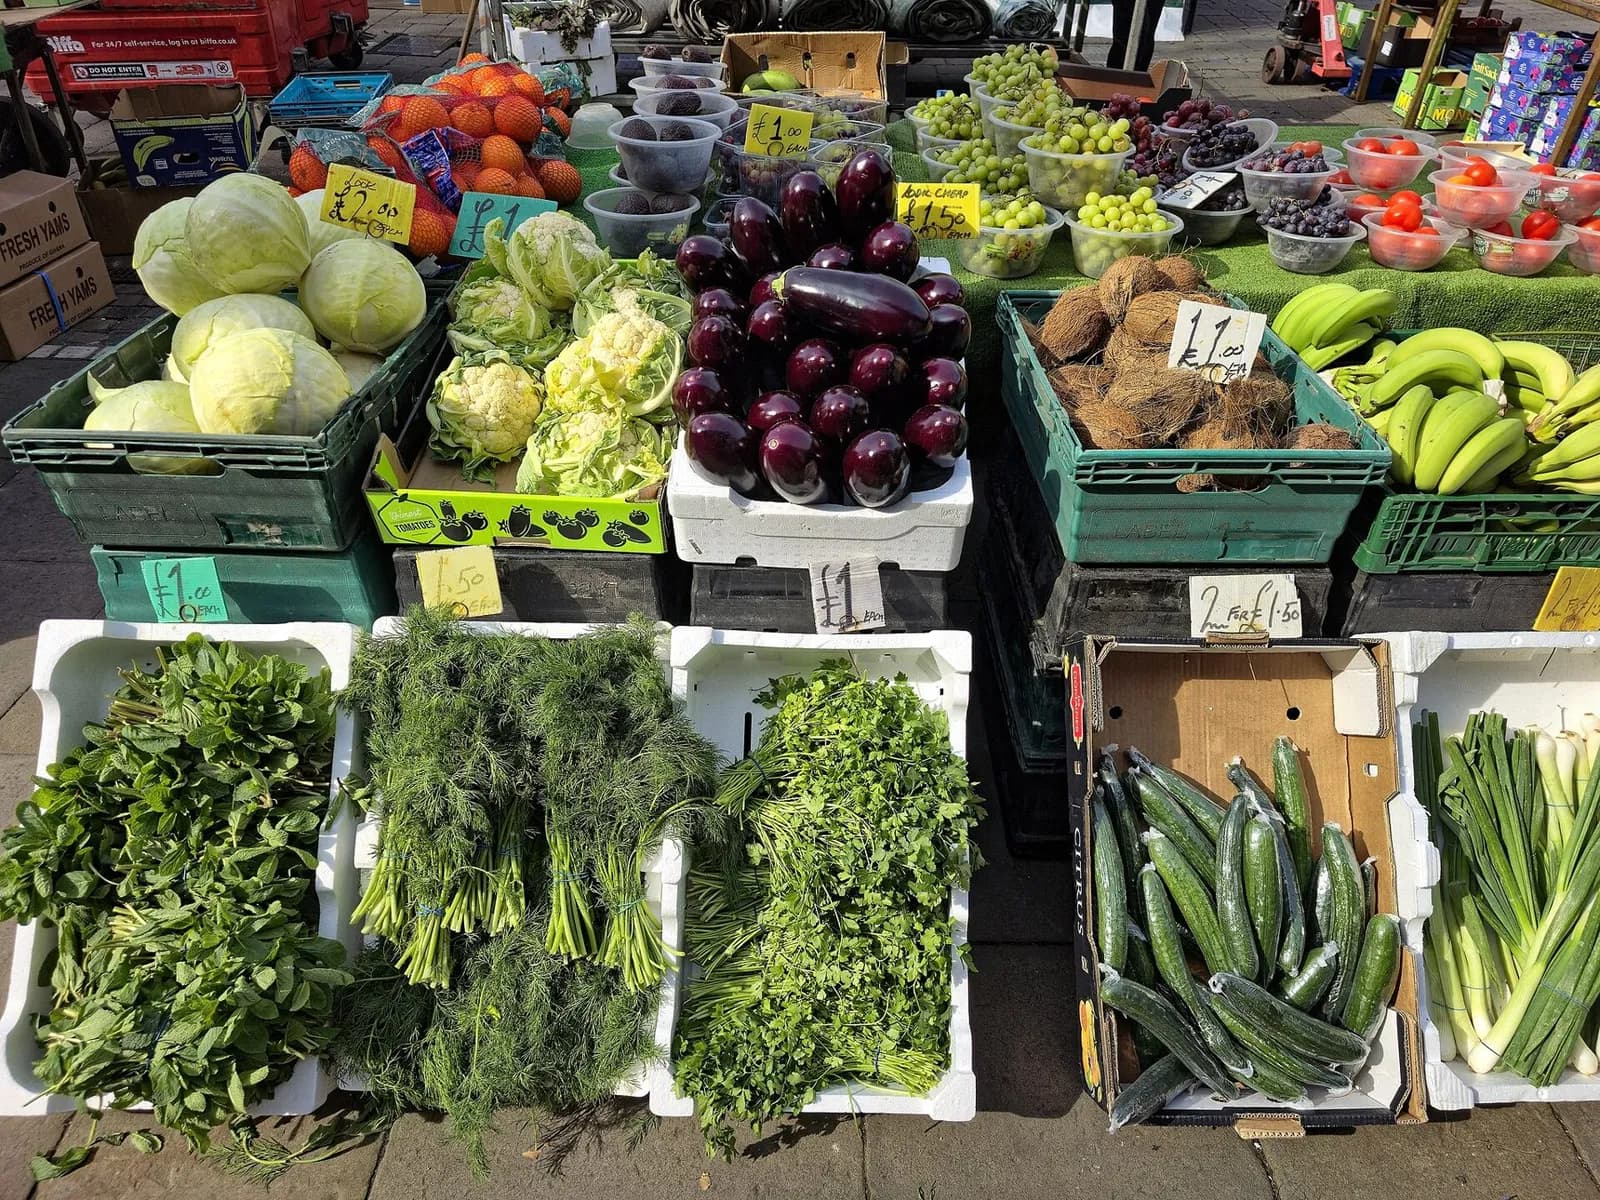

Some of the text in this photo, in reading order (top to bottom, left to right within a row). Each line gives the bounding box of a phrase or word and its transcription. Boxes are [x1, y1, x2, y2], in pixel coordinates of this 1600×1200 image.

[105, 40, 122, 48] 24/7
[124, 38, 168, 48] self-service,
[168, 38, 181, 47] log
[200, 37, 237, 45] biffa.co.uk
[101, 66, 117, 74] NOT
[118, 65, 142, 73] ENTER
[752, 112, 802, 144] £1.00
[1432, 106, 1472, 122] MON
[459, 197, 521, 254] £1
[902, 198, 966, 232] £1.50
[0, 212, 71, 262] FRESH YAMS
[28, 276, 98, 330] FREH YAMS
[394, 520, 436, 532] TOMATOES
[152, 561, 212, 618] £1.00
[1200, 585, 1229, 633] 2
[1250, 580, 1300, 628] £1.50
[1073, 826, 1084, 937] CITRUS
